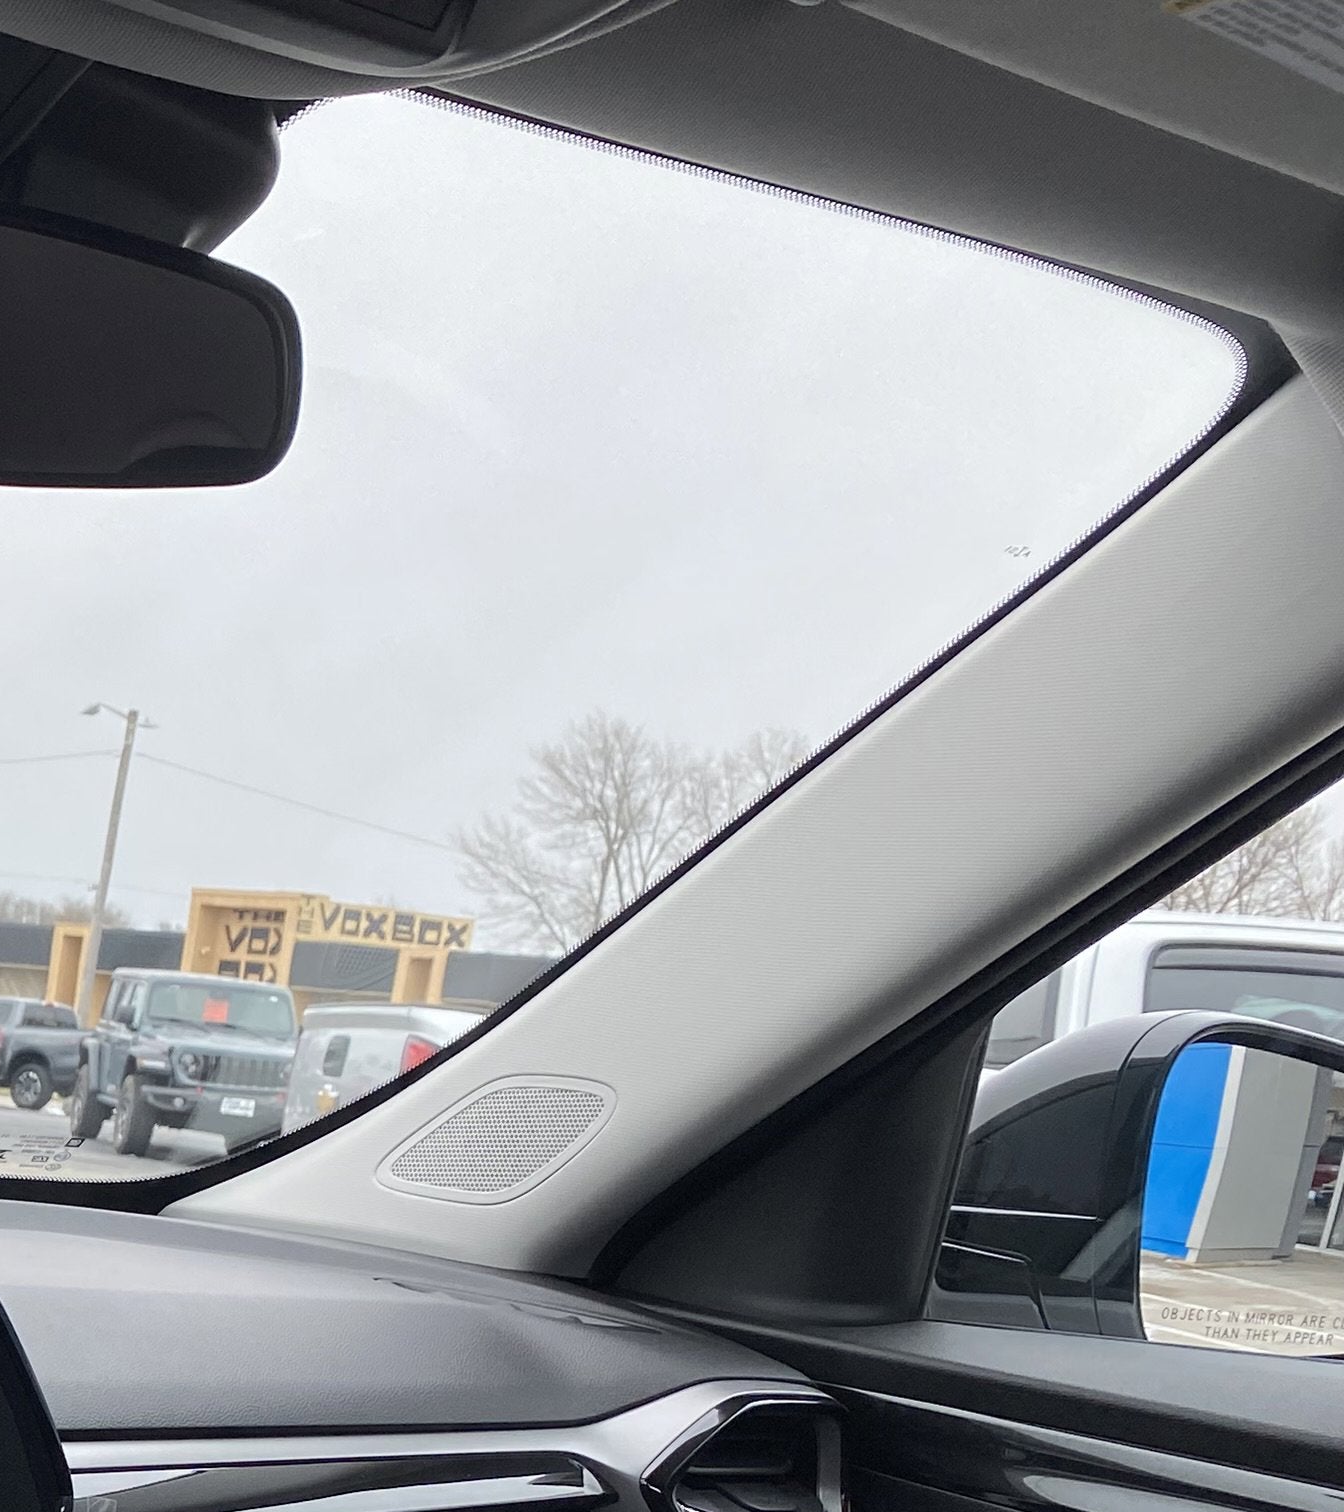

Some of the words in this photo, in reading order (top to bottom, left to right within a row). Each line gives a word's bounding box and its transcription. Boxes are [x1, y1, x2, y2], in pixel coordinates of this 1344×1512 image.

[320, 902, 469, 947] VOXBOX
[1161, 1306, 1223, 1323] OBJECTS
[1227, 1311, 1240, 1323] IN
[1244, 1312, 1294, 1327] MIRROR
[1300, 1315, 1327, 1329] ARE
[1204, 1326, 1240, 1339] THAN
[1245, 1328, 1279, 1343] THEY
[1283, 1332, 1335, 1346] APPEAR
